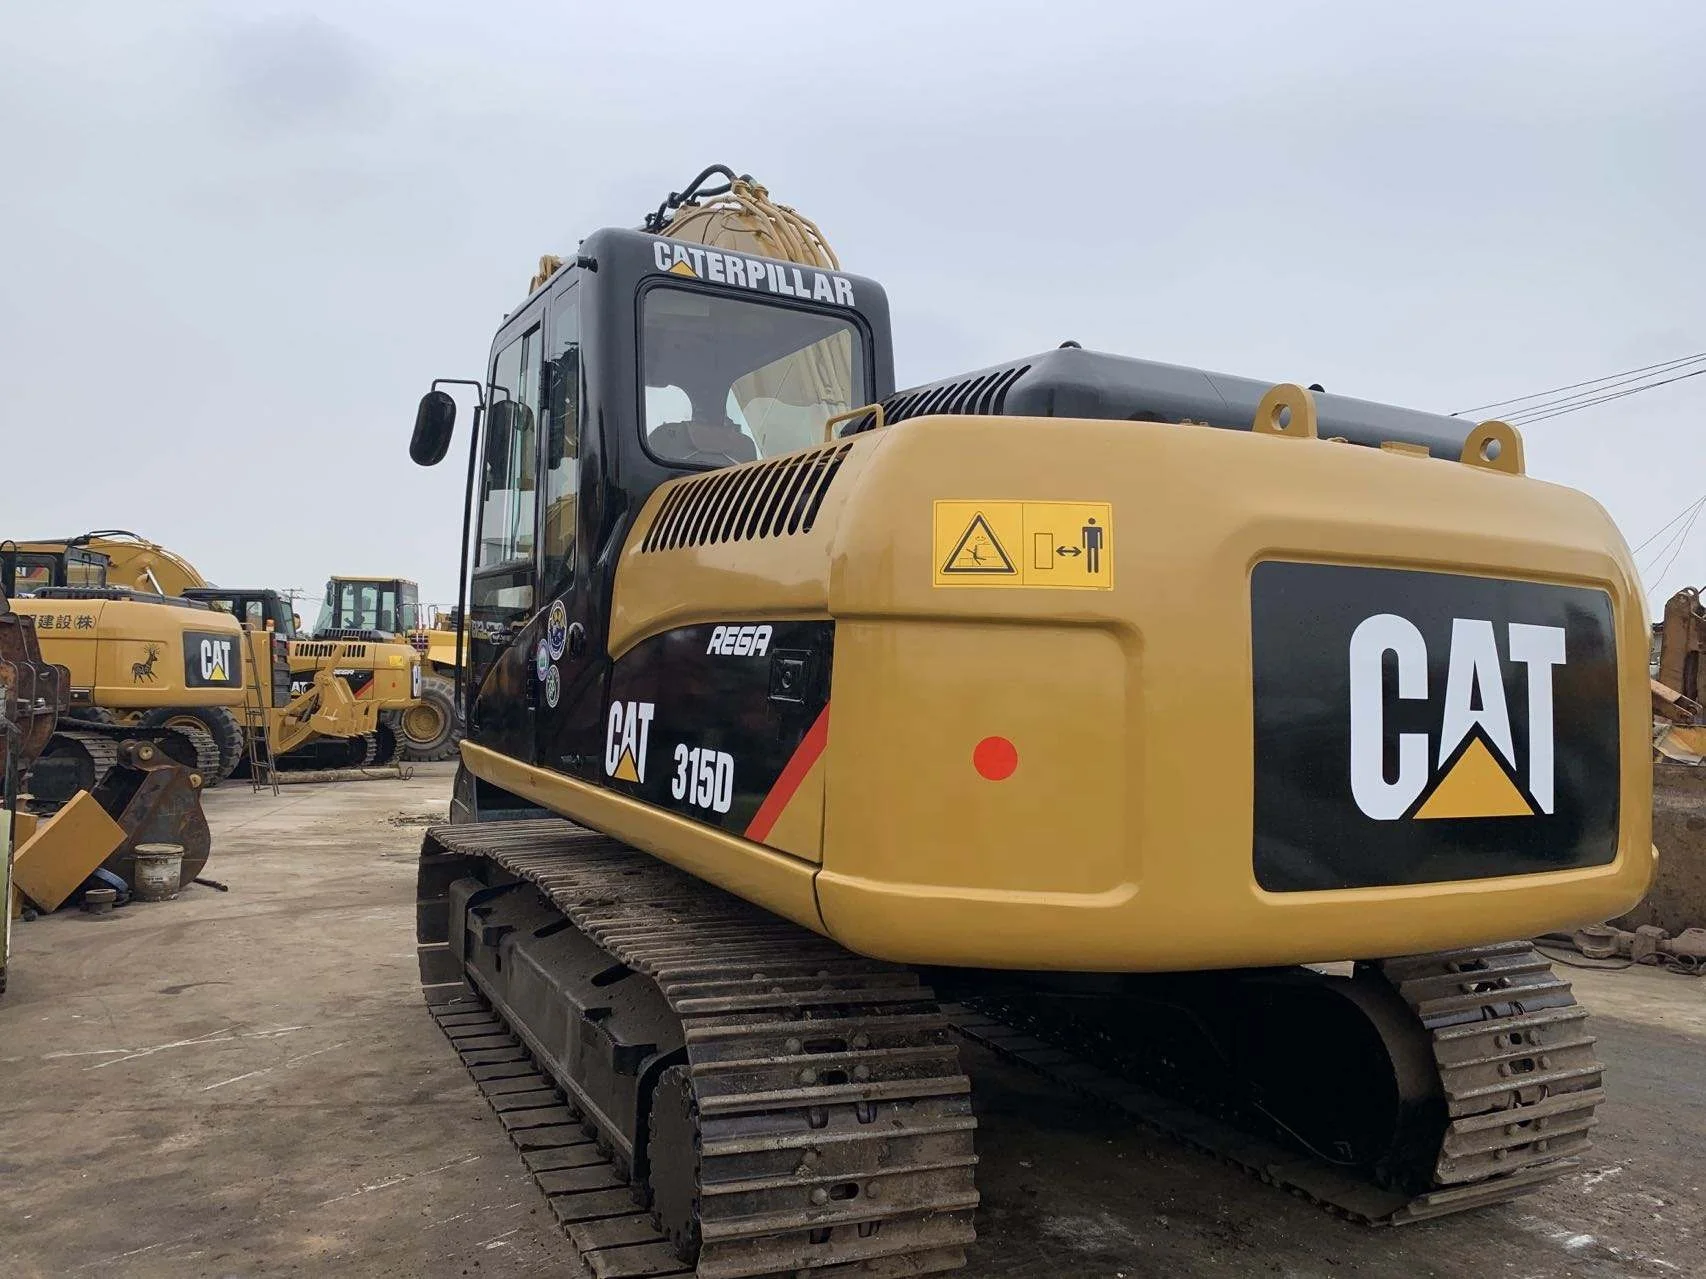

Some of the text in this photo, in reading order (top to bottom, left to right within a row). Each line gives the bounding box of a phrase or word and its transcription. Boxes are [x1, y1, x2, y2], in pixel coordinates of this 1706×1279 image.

[653, 241, 855, 307] CATERPILLAR
[30, 614, 97, 630] 建設(株)
[706, 625, 773, 657] REGA
[200, 639, 231, 681] CAT
[605, 700, 655, 784] CAT
[1349, 613, 1567, 820] CAT
[671, 743, 735, 814] 315D
